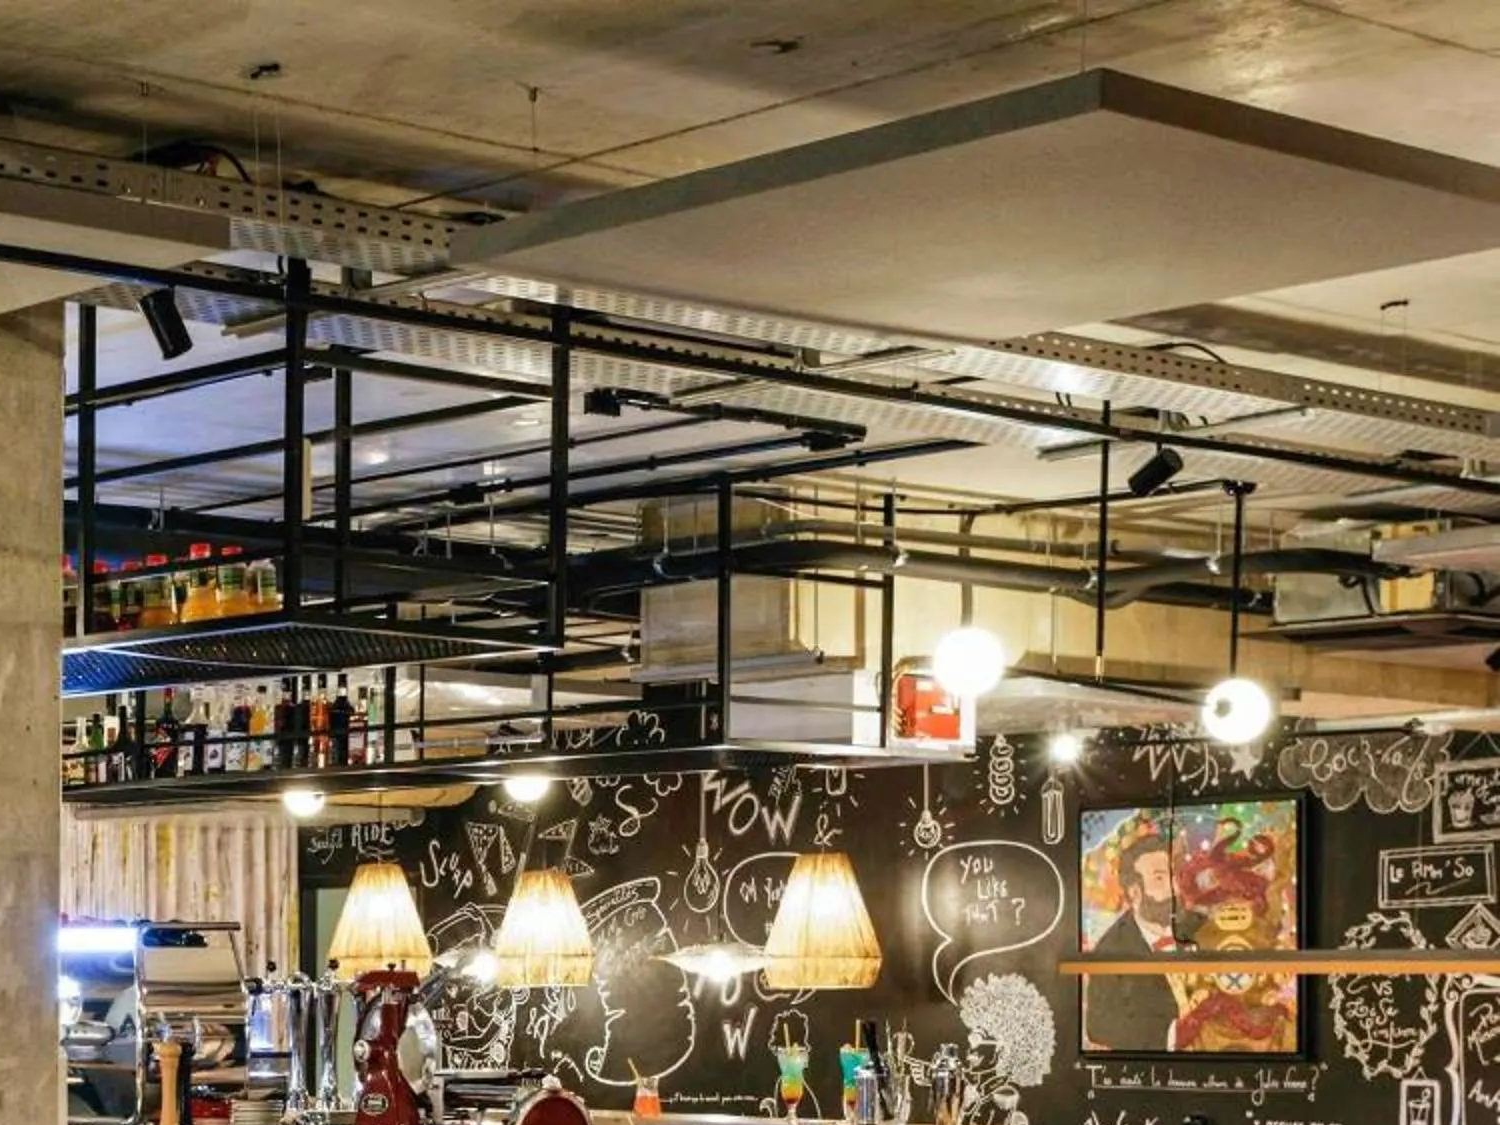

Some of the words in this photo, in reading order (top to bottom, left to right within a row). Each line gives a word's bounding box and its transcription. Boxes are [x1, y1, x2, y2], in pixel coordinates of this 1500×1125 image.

[703, 772, 802, 846] WOW
[351, 822, 396, 853] RIDE
[960, 855, 993, 884] YOU
[1011, 898, 1025, 926] ?
